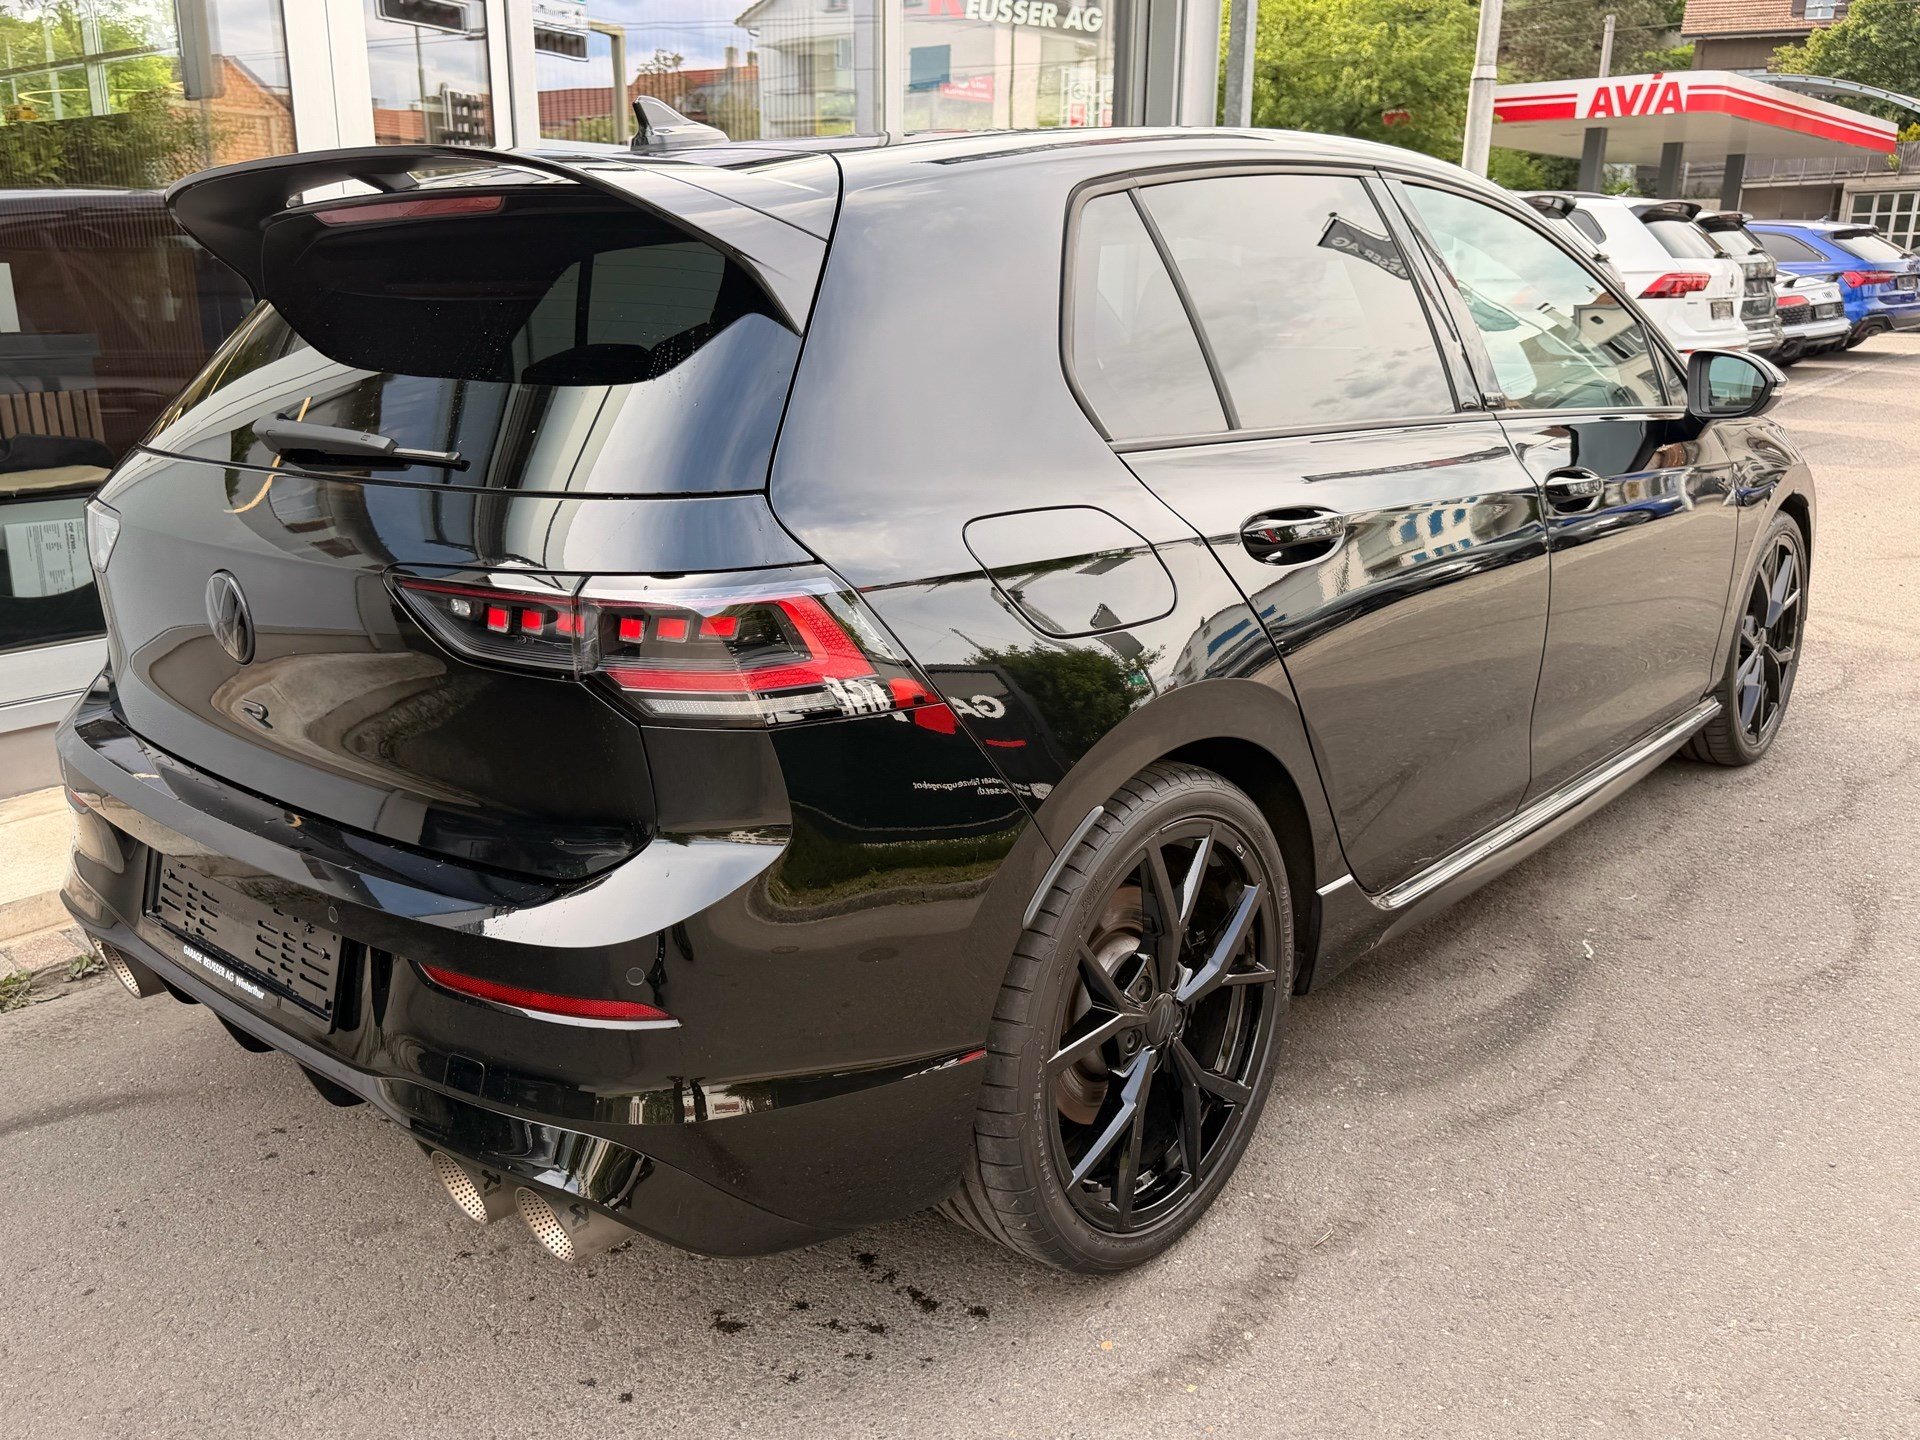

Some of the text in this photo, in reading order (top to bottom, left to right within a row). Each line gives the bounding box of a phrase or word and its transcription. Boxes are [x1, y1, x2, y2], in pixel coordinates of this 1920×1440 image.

[1062, 6, 1104, 33] AG
[1587, 71, 1683, 118] AVIA
[183, 945, 265, 999] GARAGE REUSSER AG Winterthur
